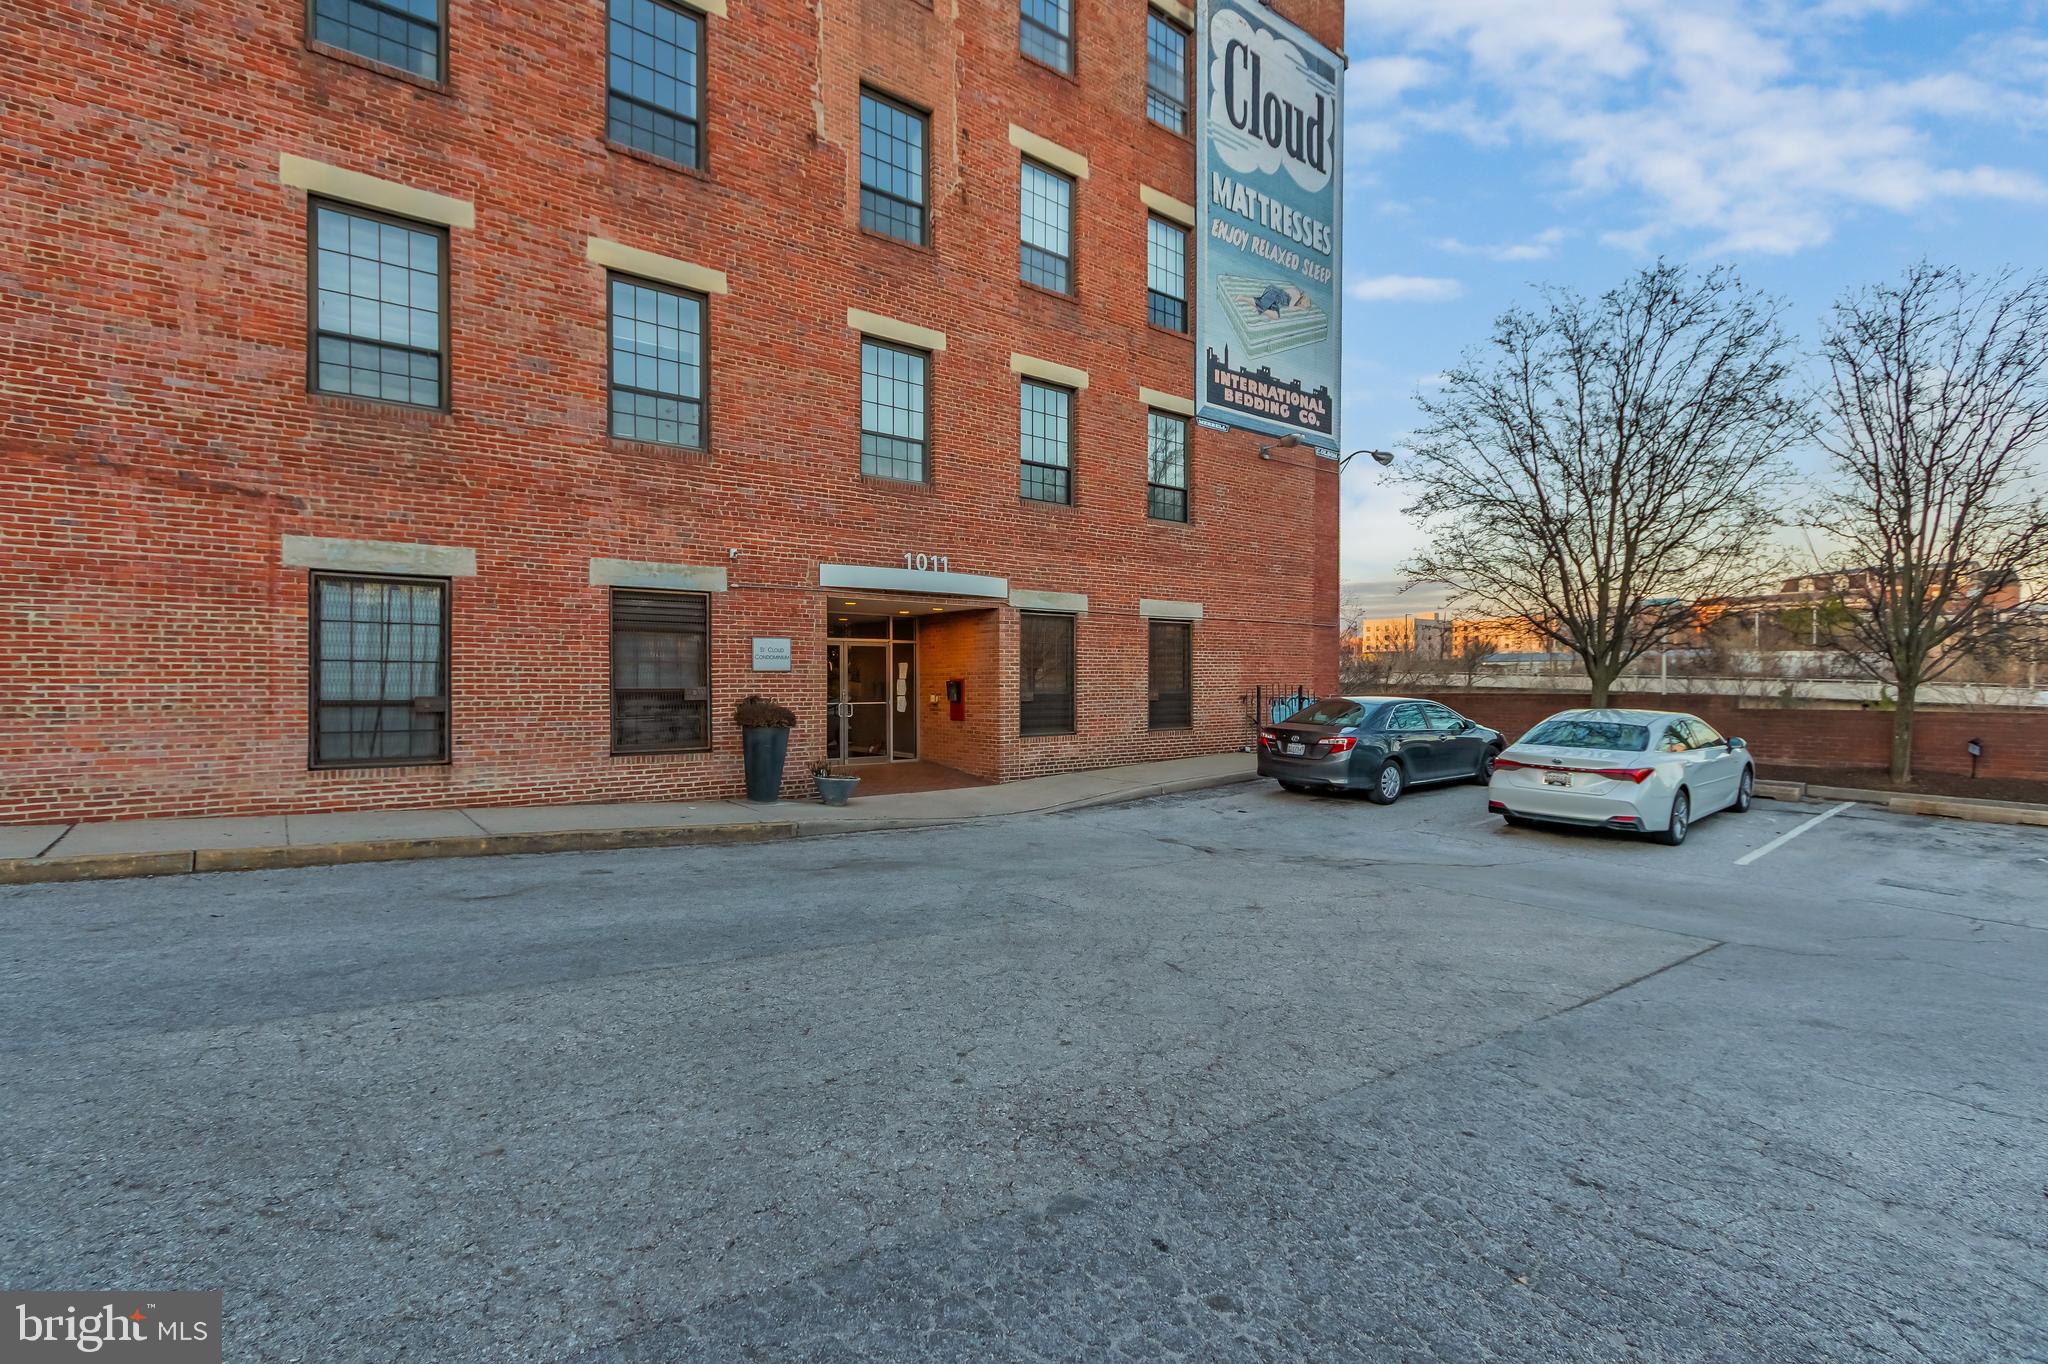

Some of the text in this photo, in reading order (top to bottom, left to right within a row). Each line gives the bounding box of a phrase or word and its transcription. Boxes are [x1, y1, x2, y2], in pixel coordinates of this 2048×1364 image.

[1224, 38, 1327, 175] Cloud
[1211, 171, 1332, 257] MATTRESSES
[1211, 218, 1332, 285] ENJOY RELAXED SLEEP
[1213, 368, 1326, 415] INTERNATIONAL
[1223, 387, 1321, 427] BEDDING CO.
[903, 552, 949, 573] 1011
